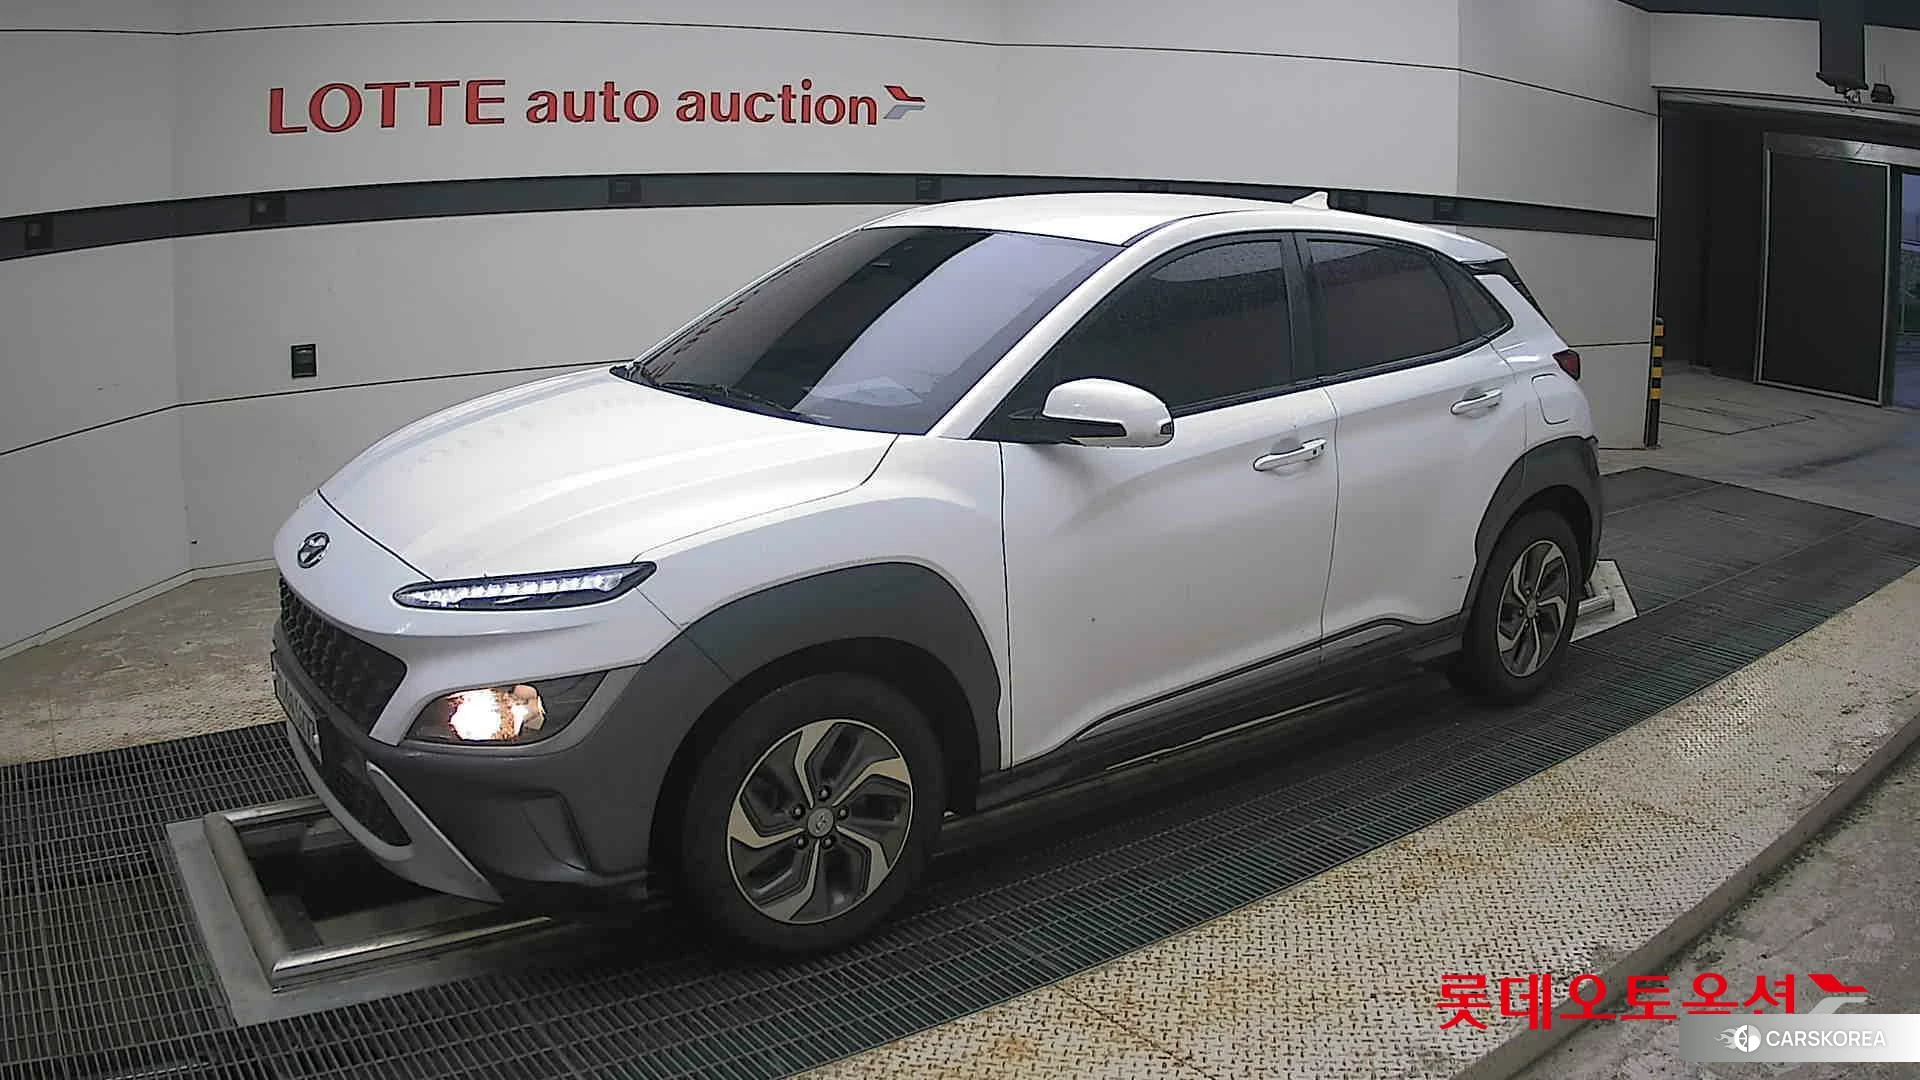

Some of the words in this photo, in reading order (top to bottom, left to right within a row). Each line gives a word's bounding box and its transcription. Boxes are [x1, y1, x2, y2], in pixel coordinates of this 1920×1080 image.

[269, 79, 505, 134] LOTTE
[526, 81, 659, 123] auto
[676, 79, 878, 125] auction
